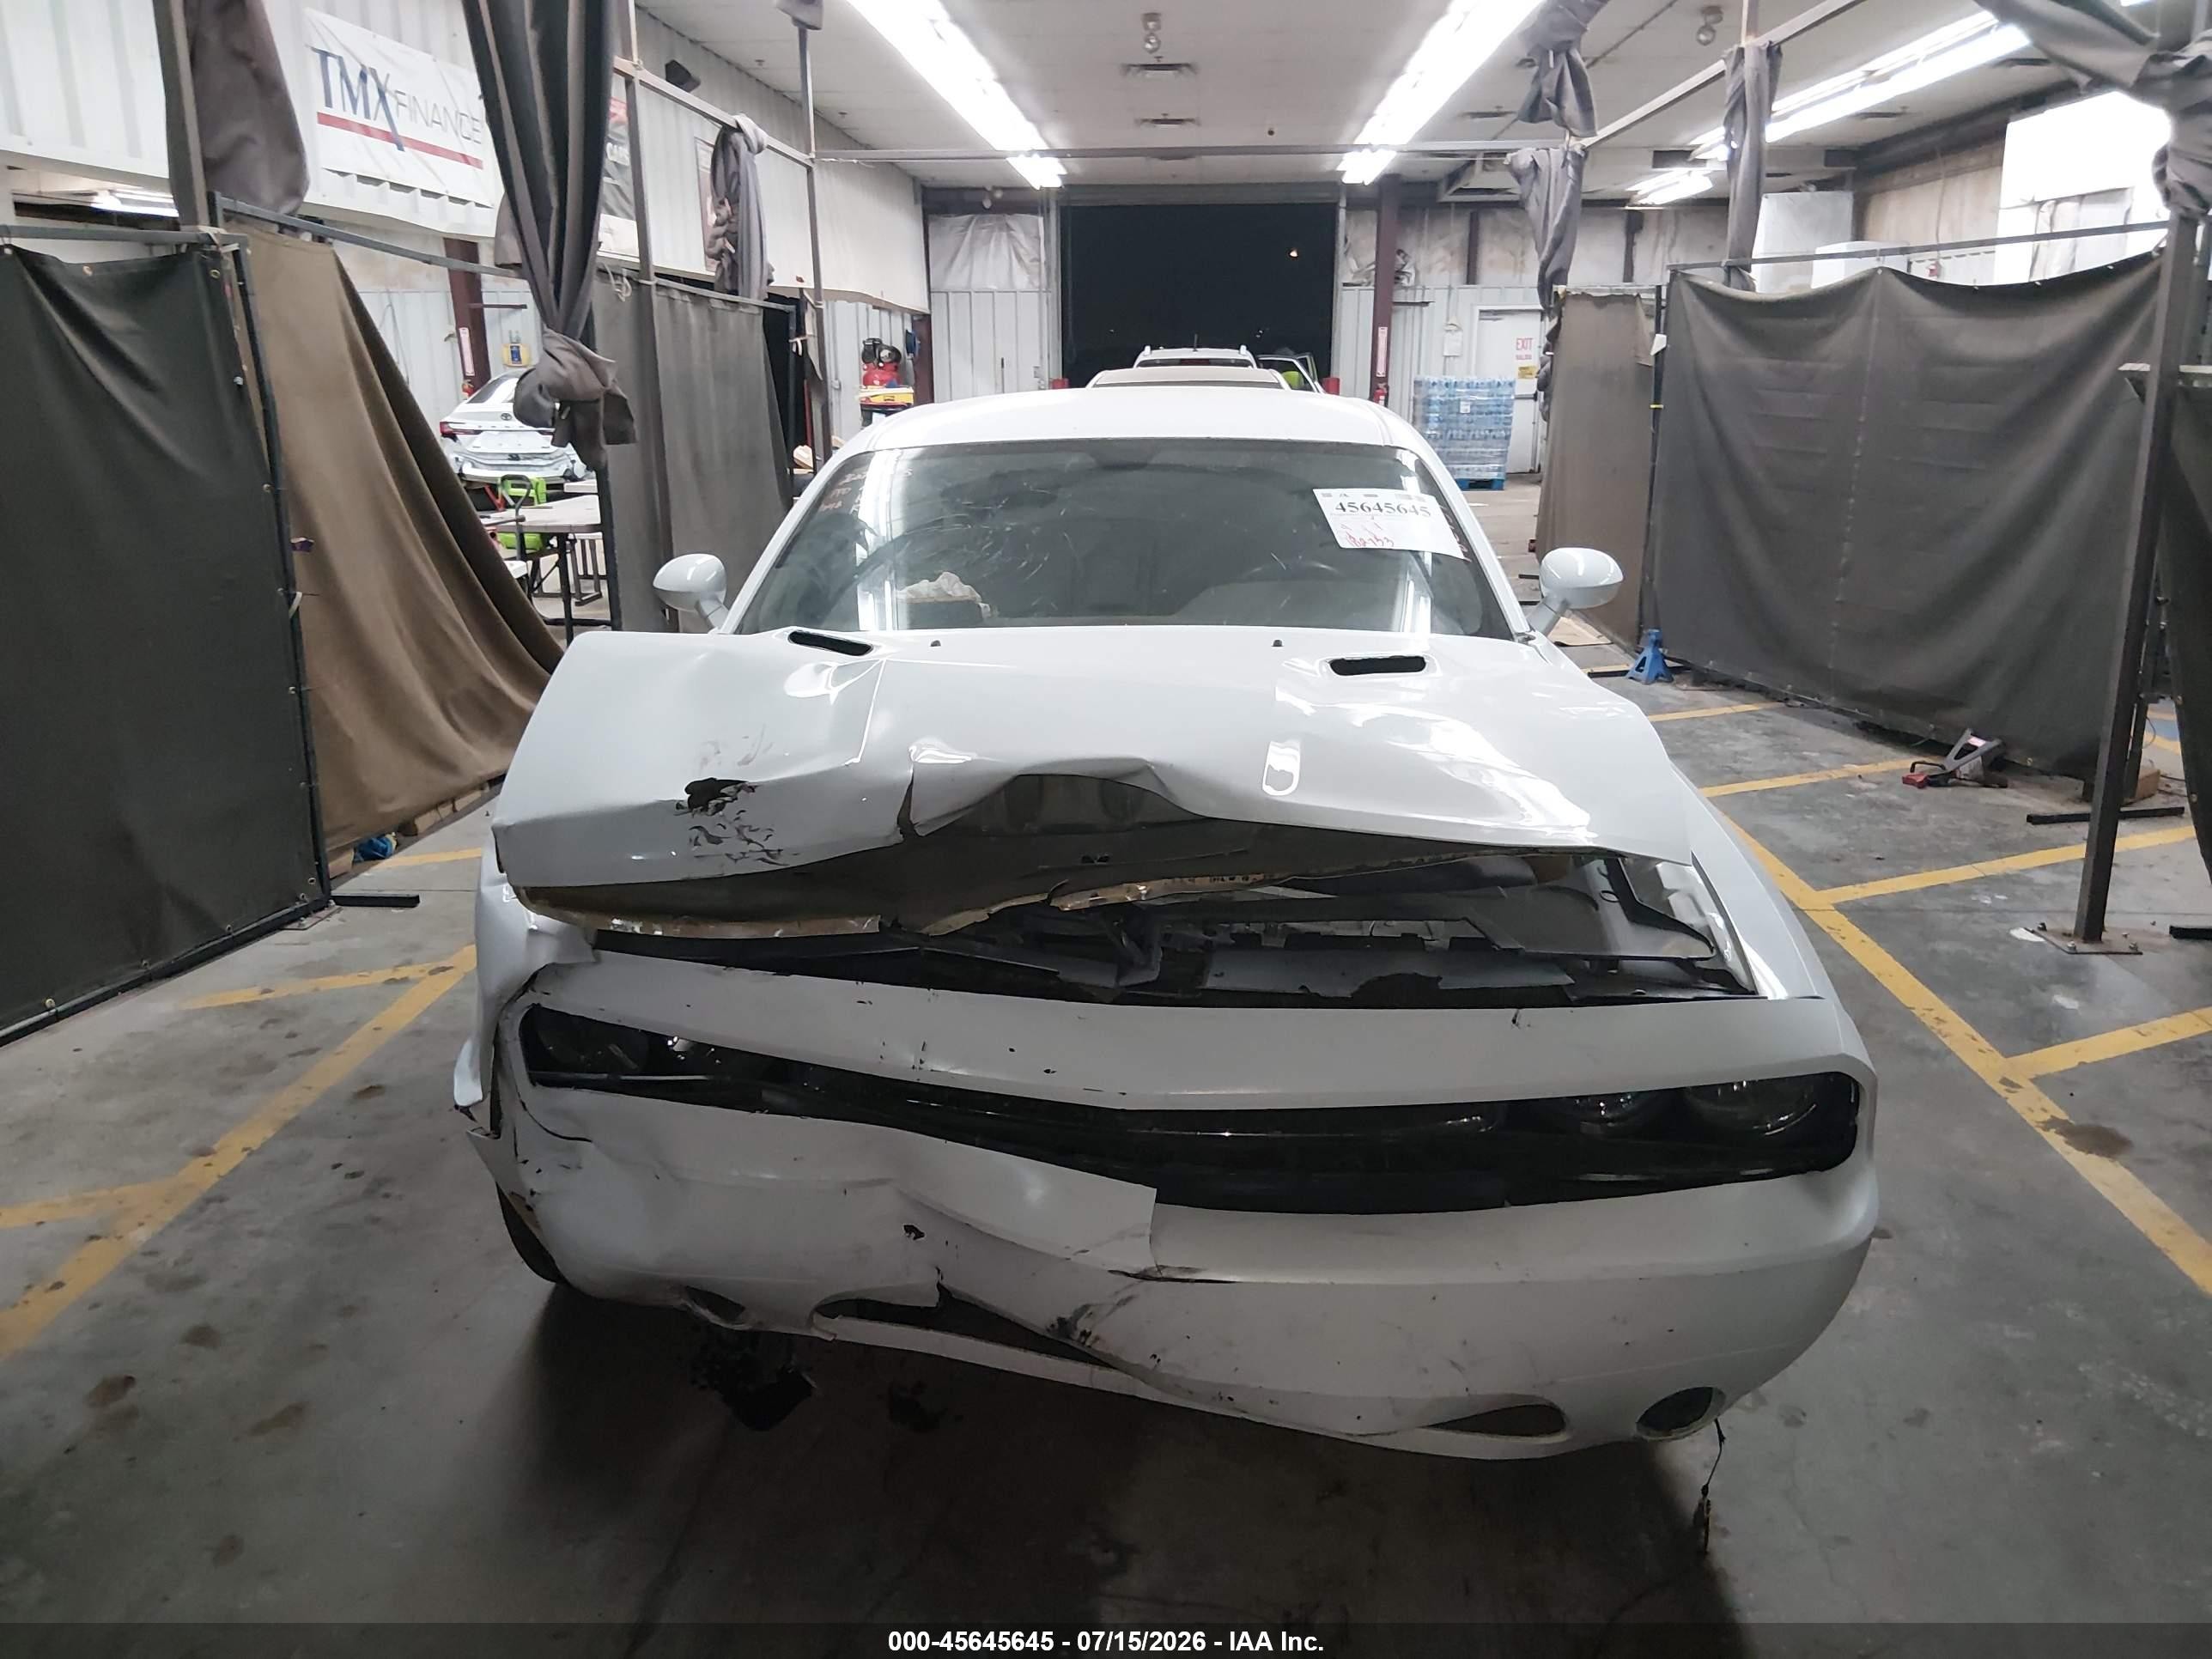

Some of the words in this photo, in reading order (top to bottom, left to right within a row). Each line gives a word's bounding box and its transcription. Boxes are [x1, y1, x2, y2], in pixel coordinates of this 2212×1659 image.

[310, 46, 404, 152] TMX
[395, 89, 482, 145] FINANCE
[1516, 337, 1533, 350] EXIT
[1335, 501, 1431, 517] 45645645
